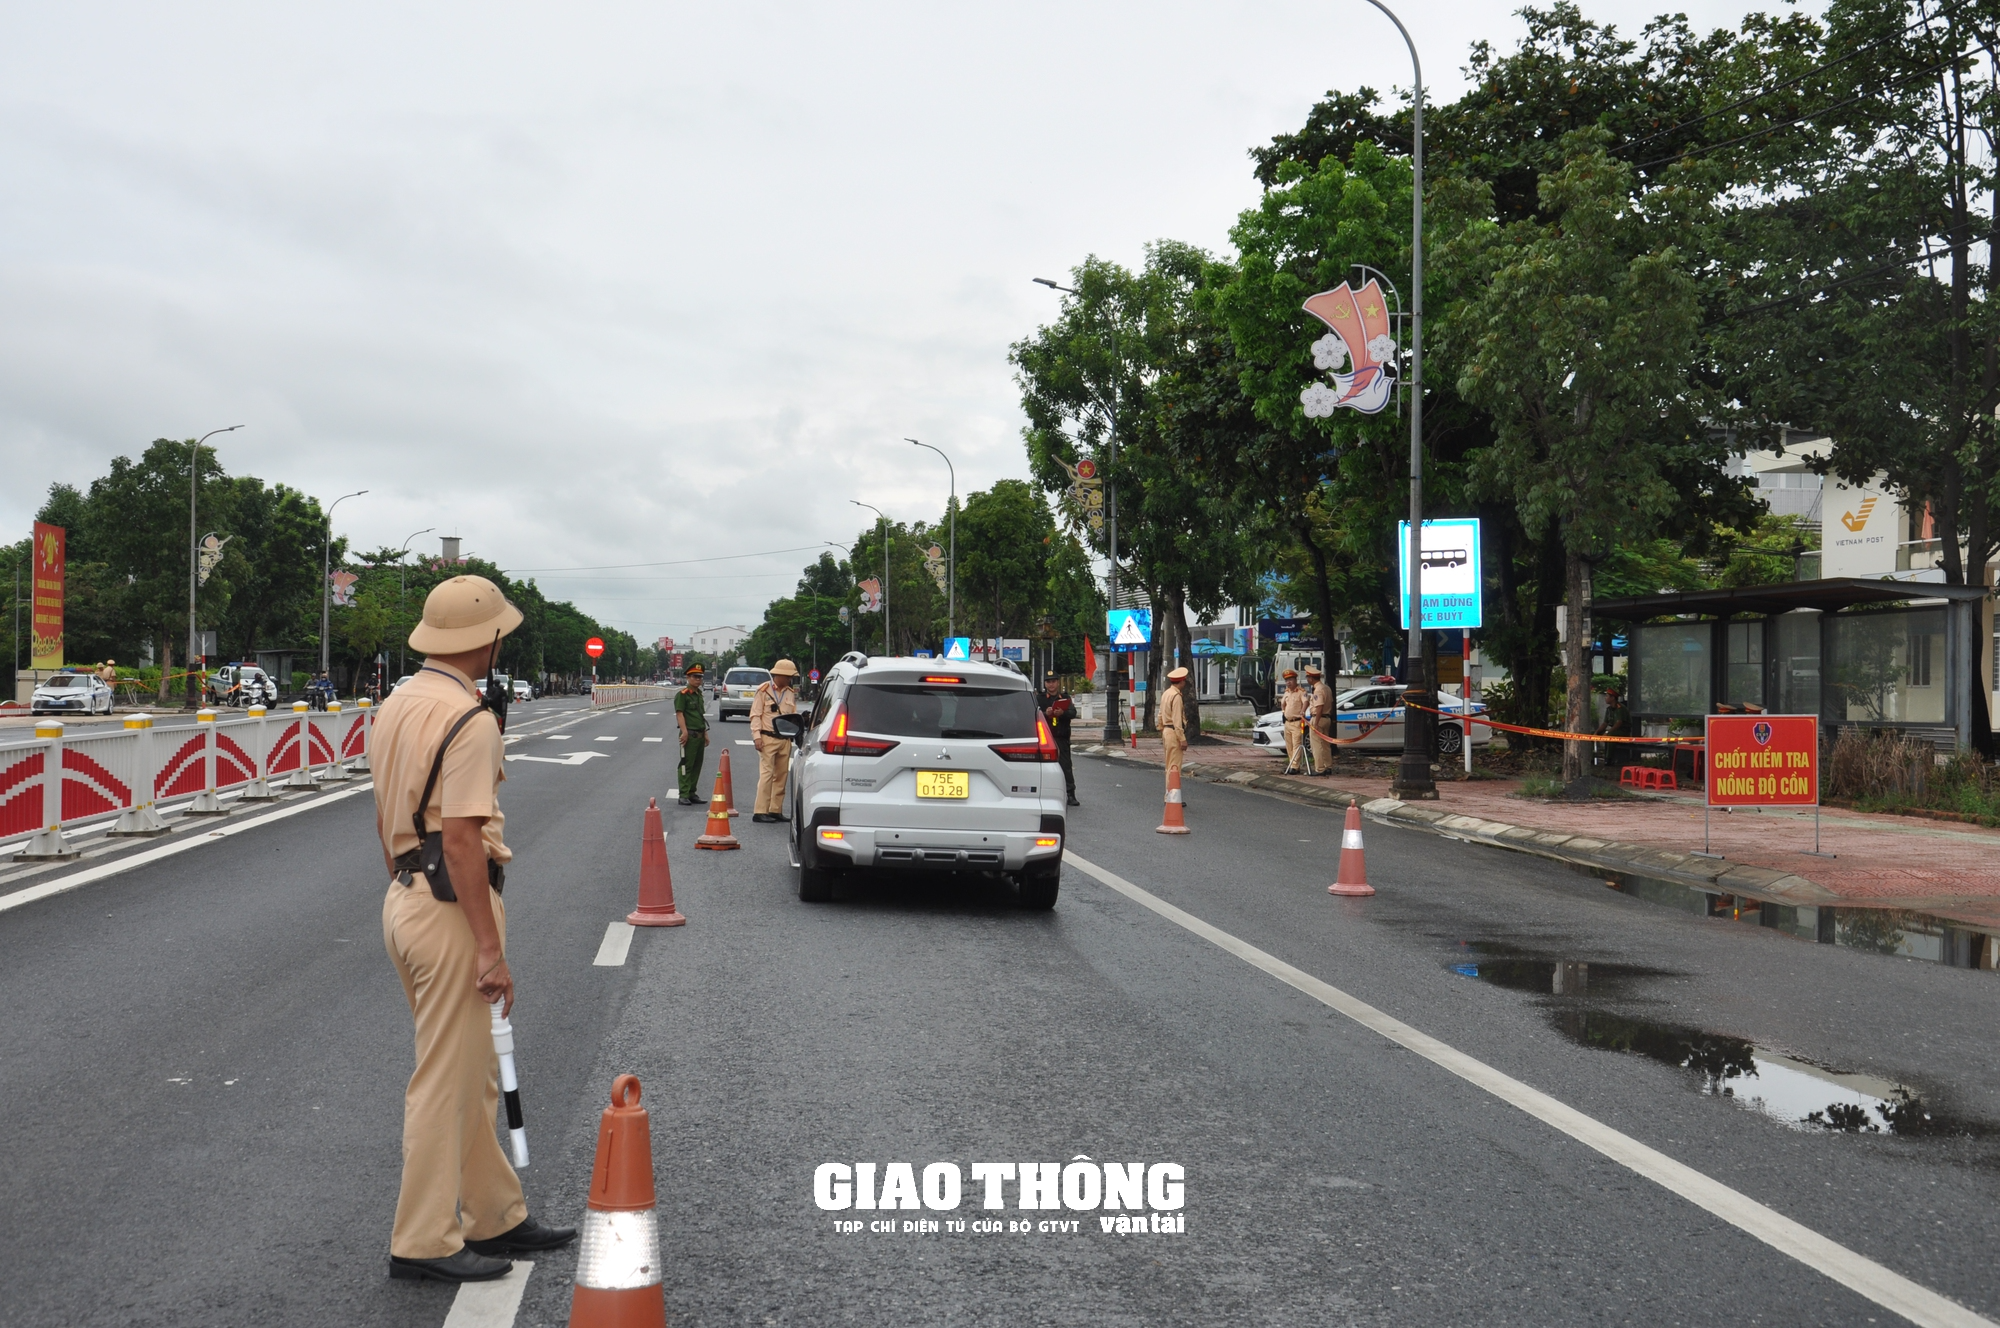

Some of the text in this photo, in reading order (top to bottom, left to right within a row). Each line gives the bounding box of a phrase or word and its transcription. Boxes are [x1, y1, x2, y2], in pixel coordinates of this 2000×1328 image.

[1443, 596, 1473, 607] DỪNG
[1420, 609, 1463, 621] XE BUÝT
[1715, 745, 1809, 768] CHỐT KIỂM TRA
[932, 773, 954, 784] 75E
[922, 785, 963, 796] 013.28
[1717, 771, 1808, 799] NỒNG ĐỘ CỒN
